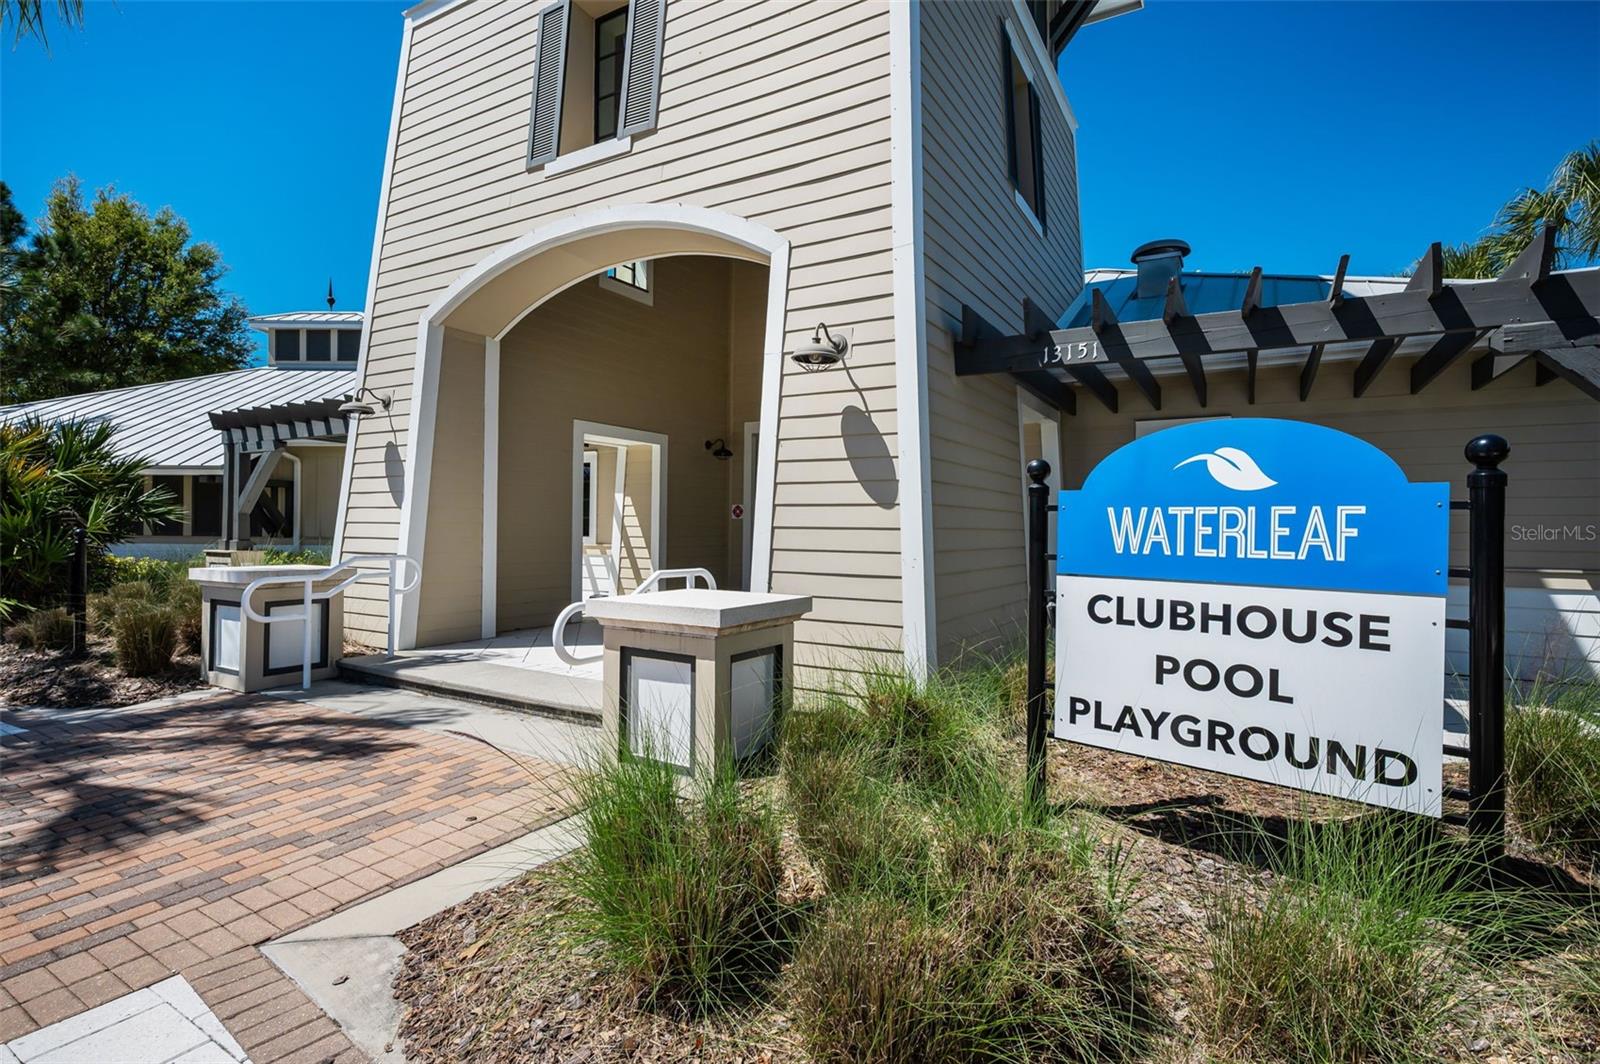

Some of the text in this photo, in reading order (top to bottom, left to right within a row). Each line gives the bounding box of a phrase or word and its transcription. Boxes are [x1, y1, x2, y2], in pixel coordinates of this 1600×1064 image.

[1042, 342, 1098, 364] 13151
[1107, 505, 1366, 561] WATERLEAF
[1087, 594, 1391, 651] CLUBHOUSE
[1155, 654, 1294, 704] POOL
[1068, 696, 1418, 788] PLAYGROUND
